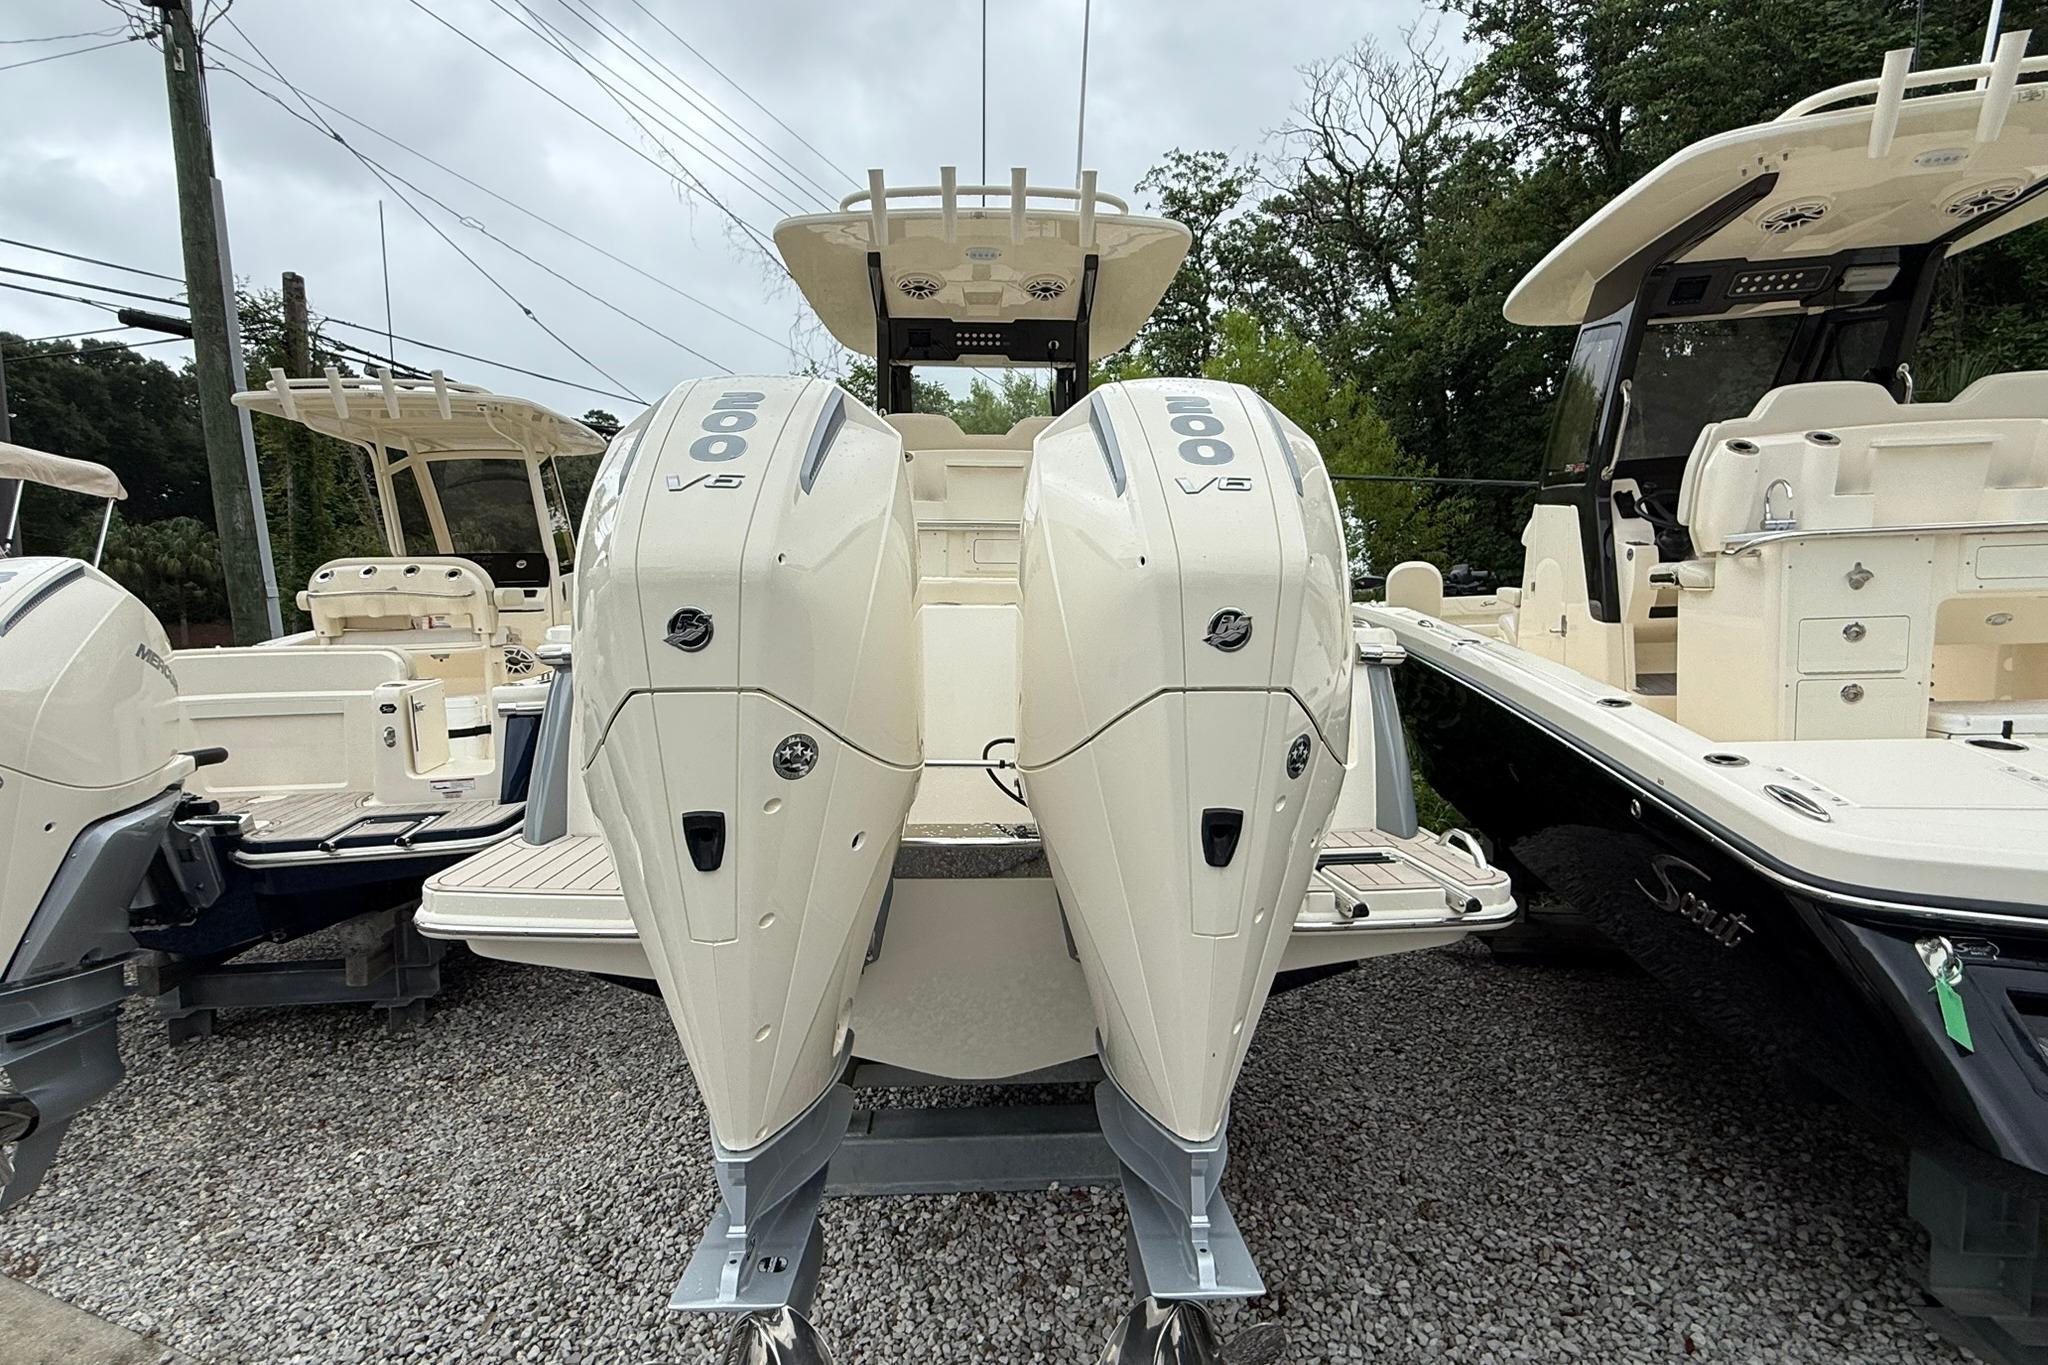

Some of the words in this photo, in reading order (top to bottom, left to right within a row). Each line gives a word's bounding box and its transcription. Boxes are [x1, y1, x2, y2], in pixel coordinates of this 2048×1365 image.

[689, 391, 766, 462] 200
[1165, 396, 1235, 466] 200
[666, 473, 746, 492] V6
[1174, 476, 1252, 495] V6
[1634, 853, 1755, 948] Scout
